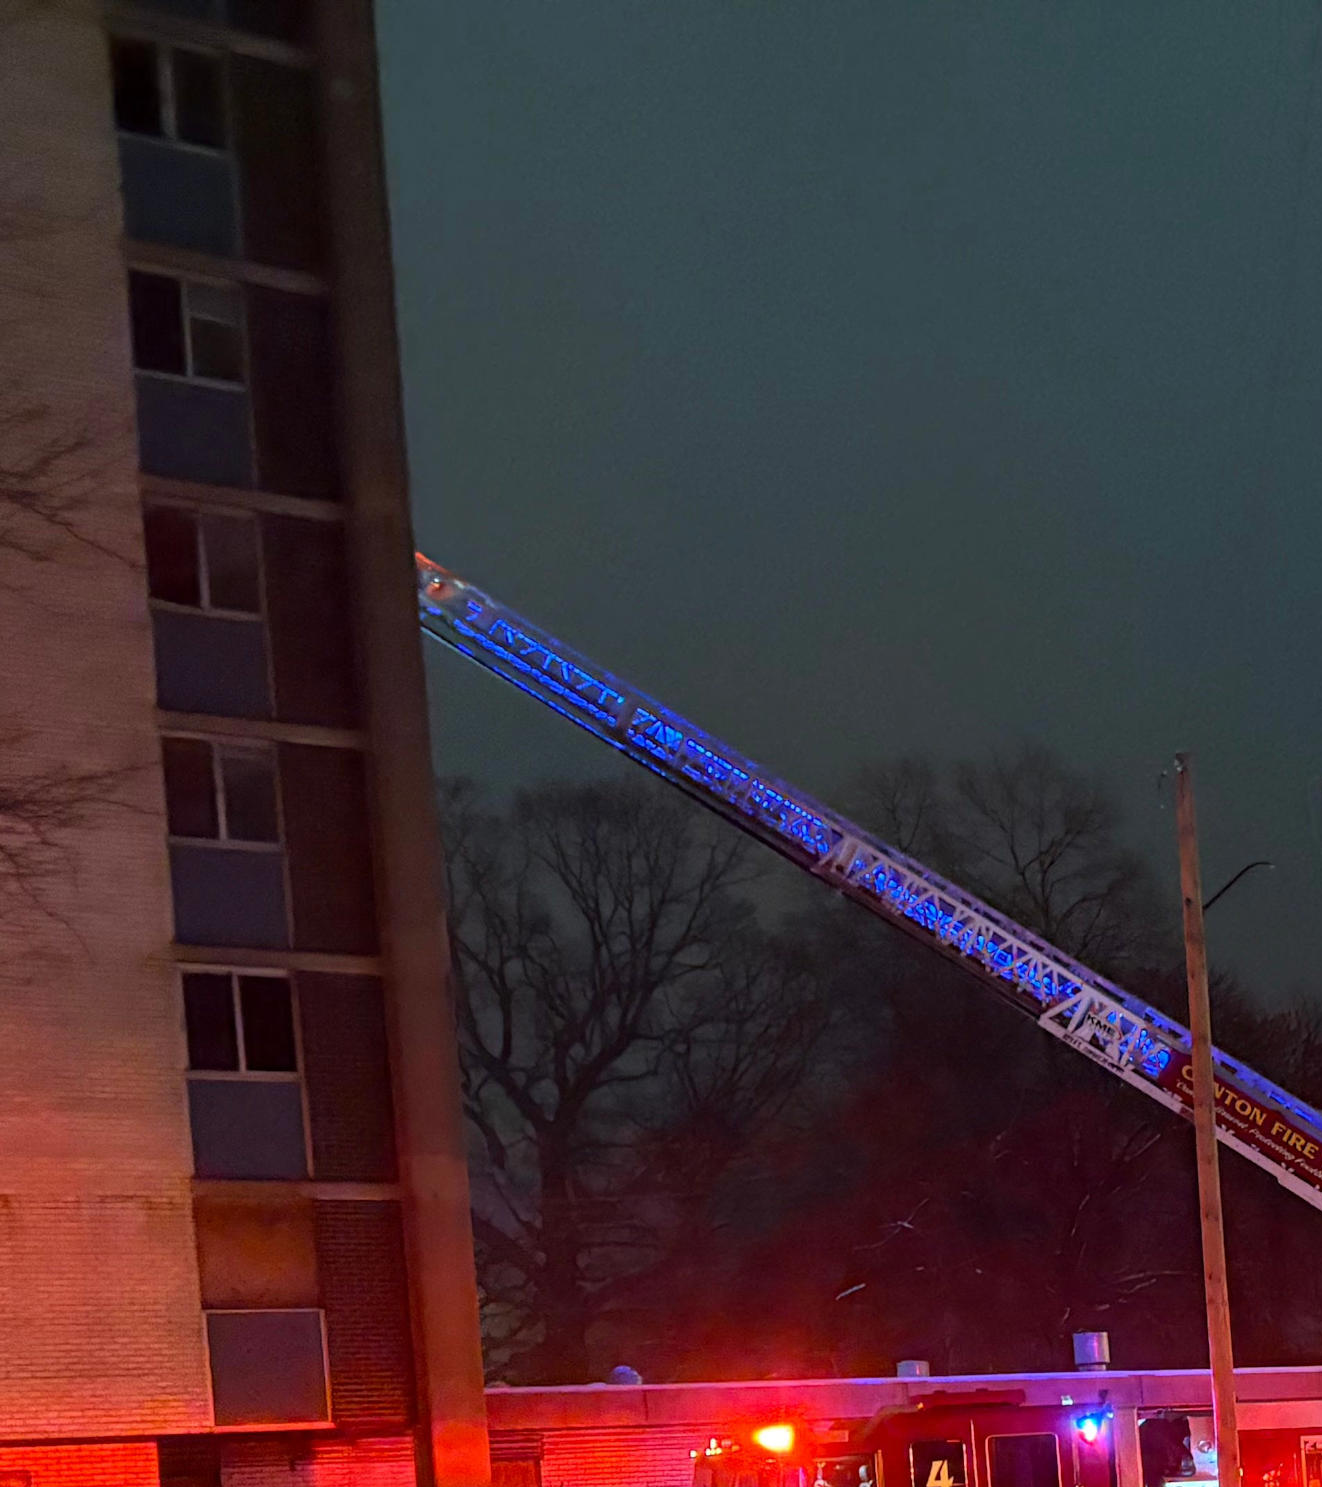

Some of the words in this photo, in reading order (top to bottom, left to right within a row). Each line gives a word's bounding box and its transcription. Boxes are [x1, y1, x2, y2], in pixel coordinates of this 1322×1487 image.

[1087, 1014, 1116, 1037] KME
[1182, 1065, 1267, 1126] CNTON
[1271, 1122, 1320, 1160] FIRE
